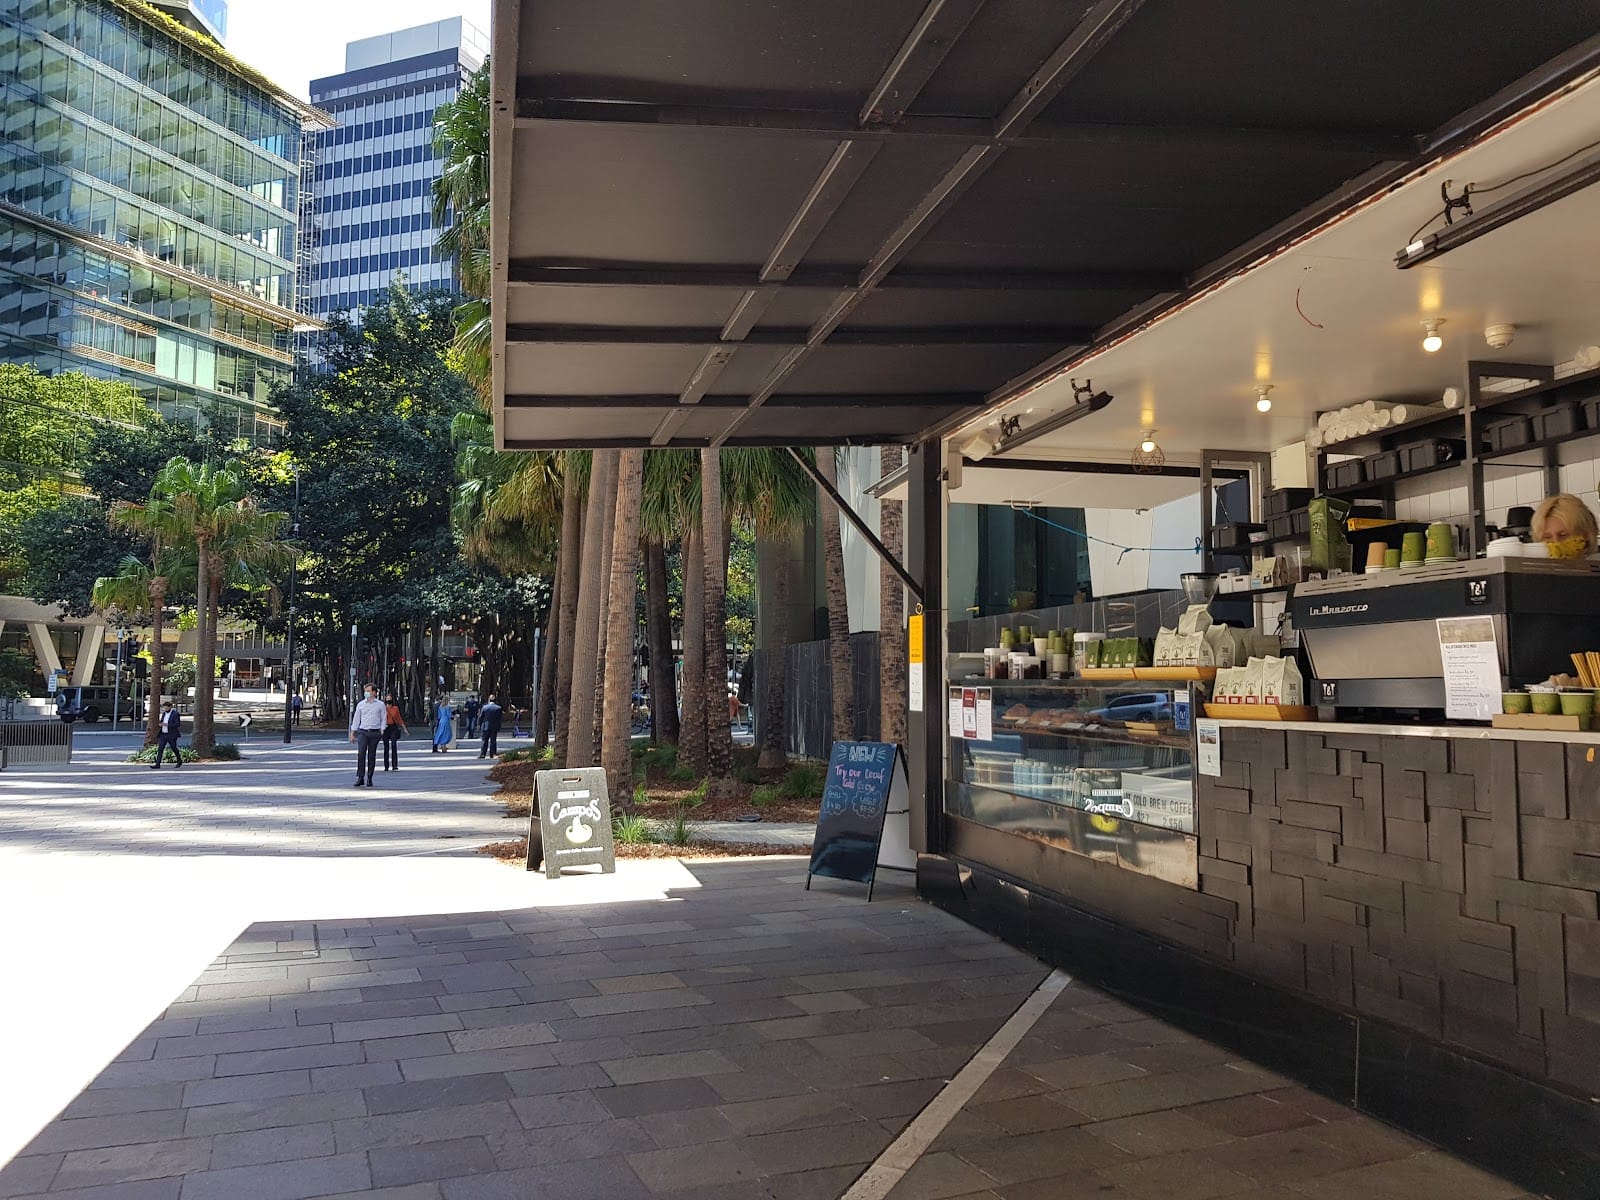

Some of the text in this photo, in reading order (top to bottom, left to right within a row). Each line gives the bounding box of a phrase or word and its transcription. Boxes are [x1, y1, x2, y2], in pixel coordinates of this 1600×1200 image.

[849, 745, 876, 761] NEW
[1133, 794, 1147, 807] COLD
[1149, 797, 1166, 810] BREW
